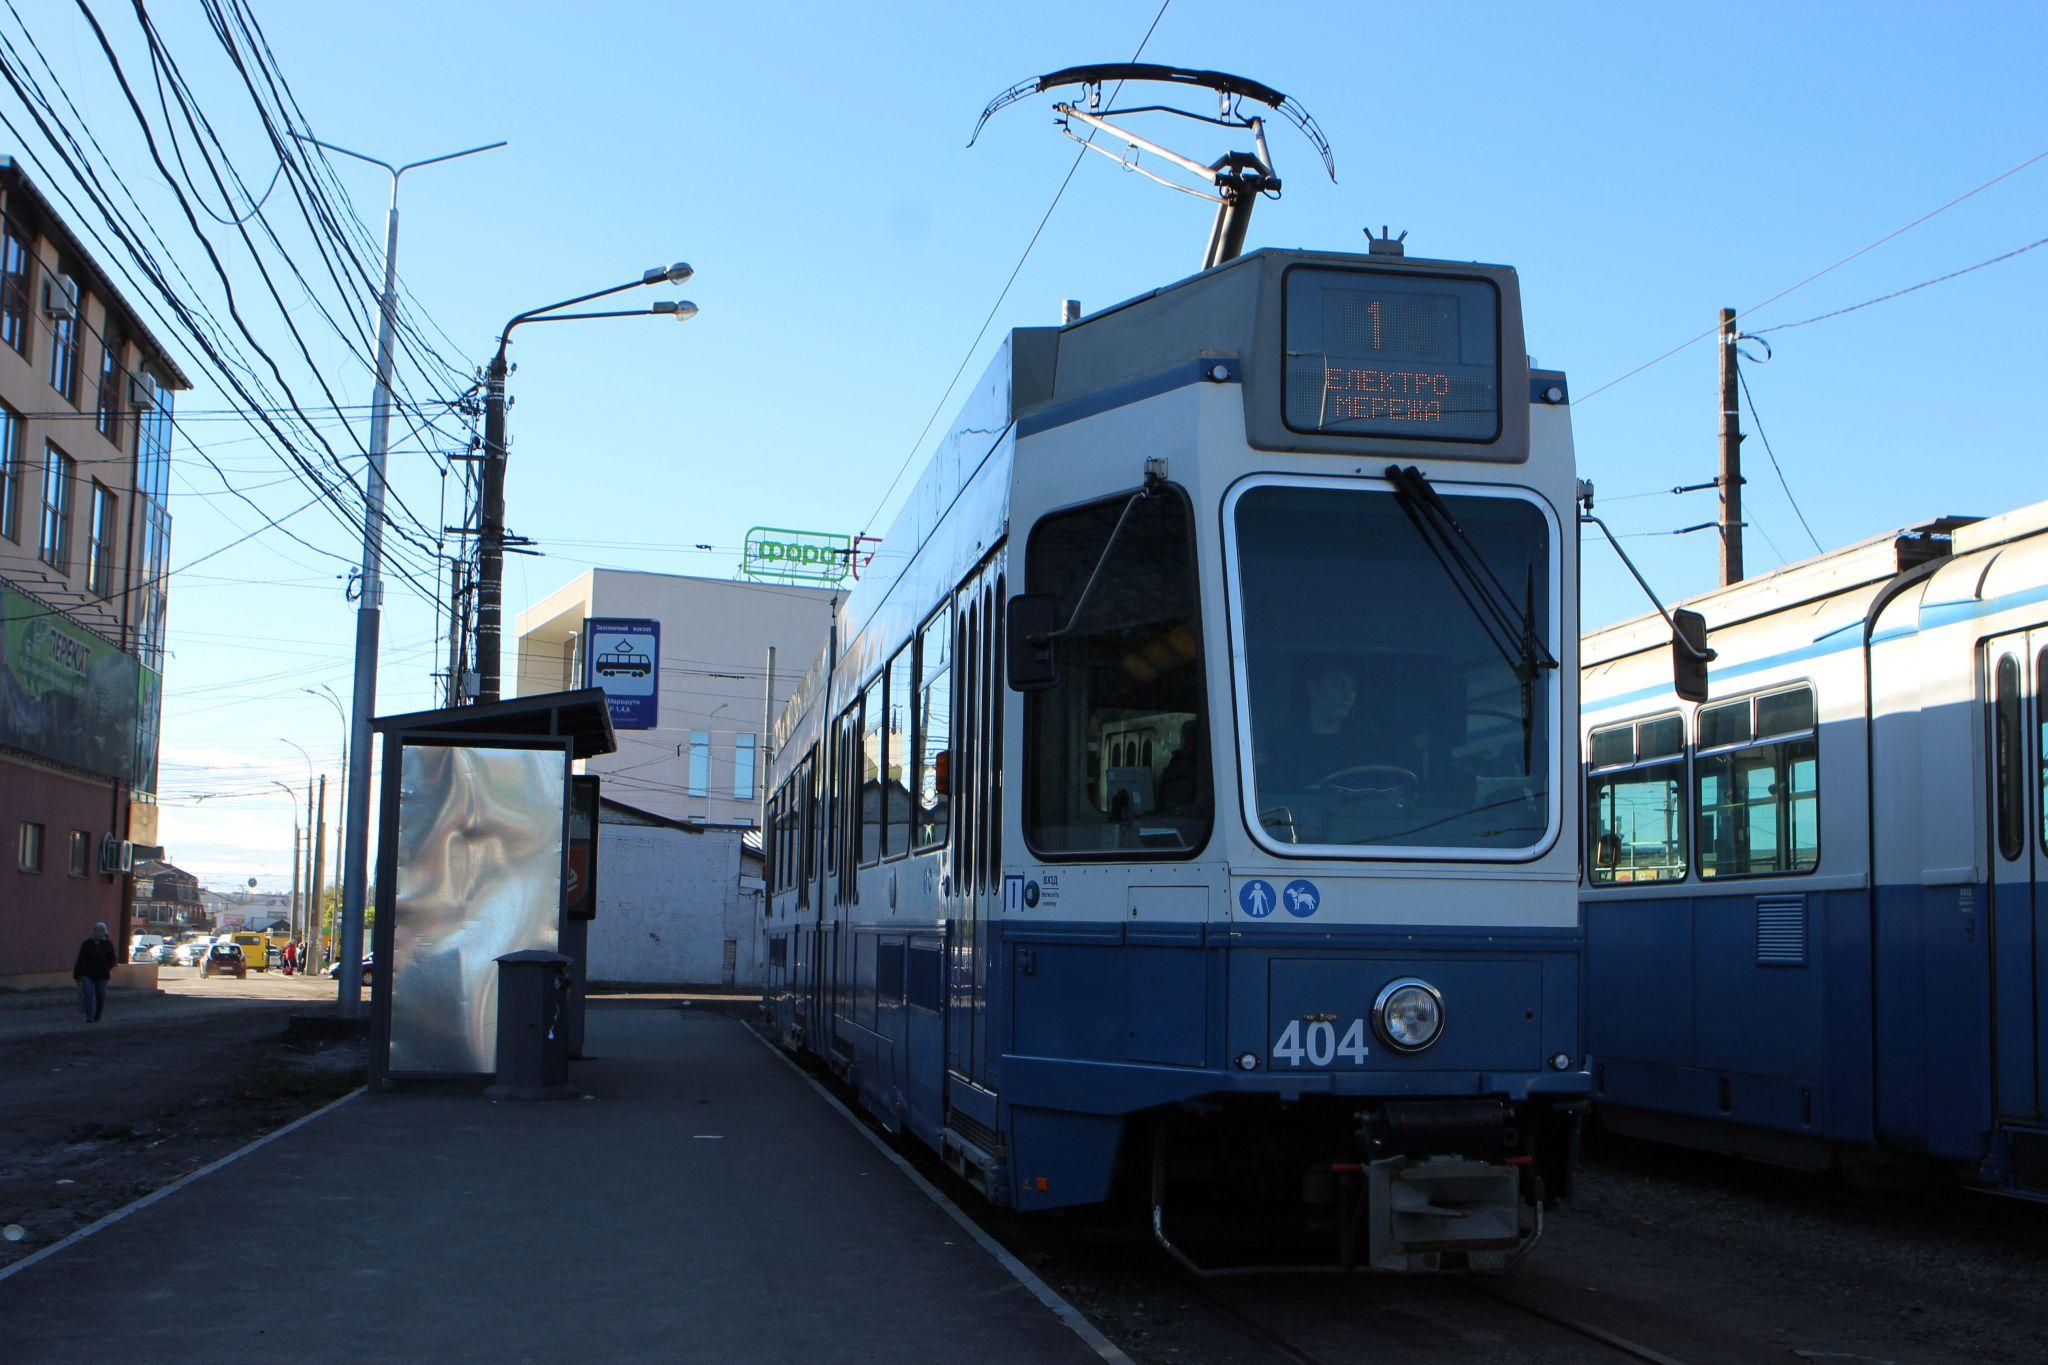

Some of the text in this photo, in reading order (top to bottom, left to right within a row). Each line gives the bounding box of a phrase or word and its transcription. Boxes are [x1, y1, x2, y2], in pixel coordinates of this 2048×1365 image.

[1367, 300, 1380, 349] 1
[1326, 368, 1449, 395] ЕЛЕКТРО
[1335, 394, 1441, 422] МЕРЕЖА
[1272, 1018, 1369, 1066] 404
